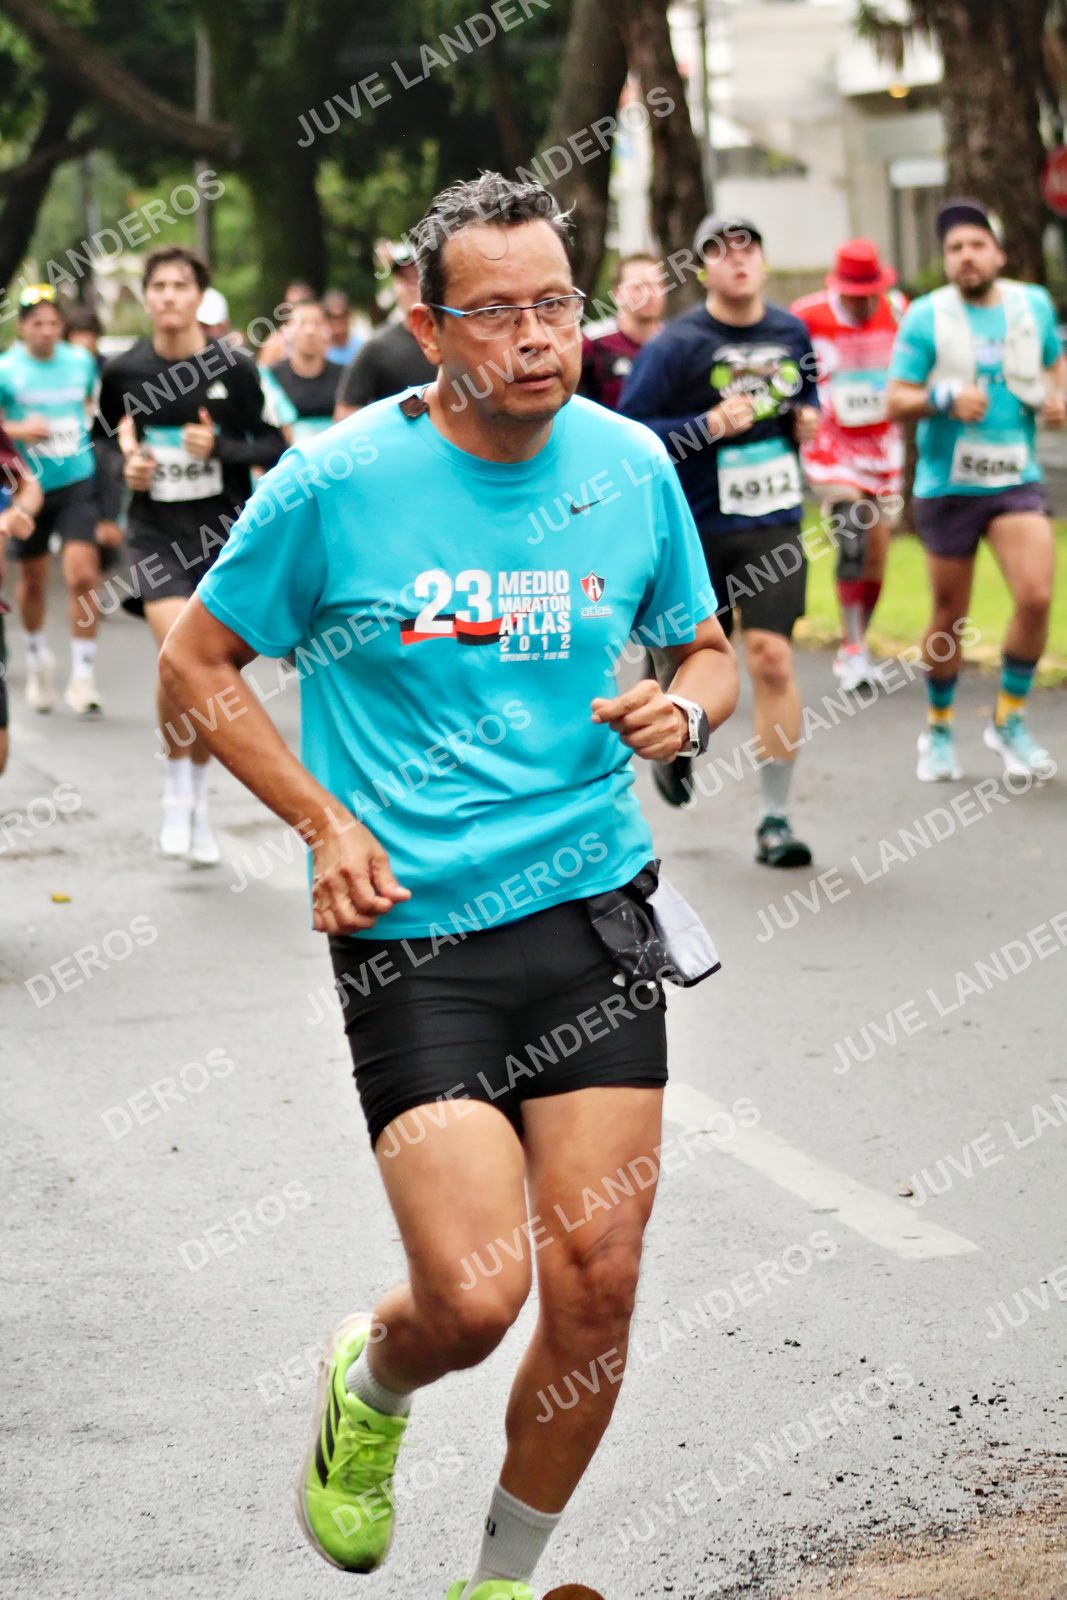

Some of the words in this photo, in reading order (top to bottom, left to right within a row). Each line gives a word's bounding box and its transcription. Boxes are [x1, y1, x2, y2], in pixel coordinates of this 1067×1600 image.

[499, 569, 570, 595] MEDIO
[413, 569, 493, 633] 23
[498, 593, 572, 613] MARATÓN
[498, 611, 571, 635] ATLAS
